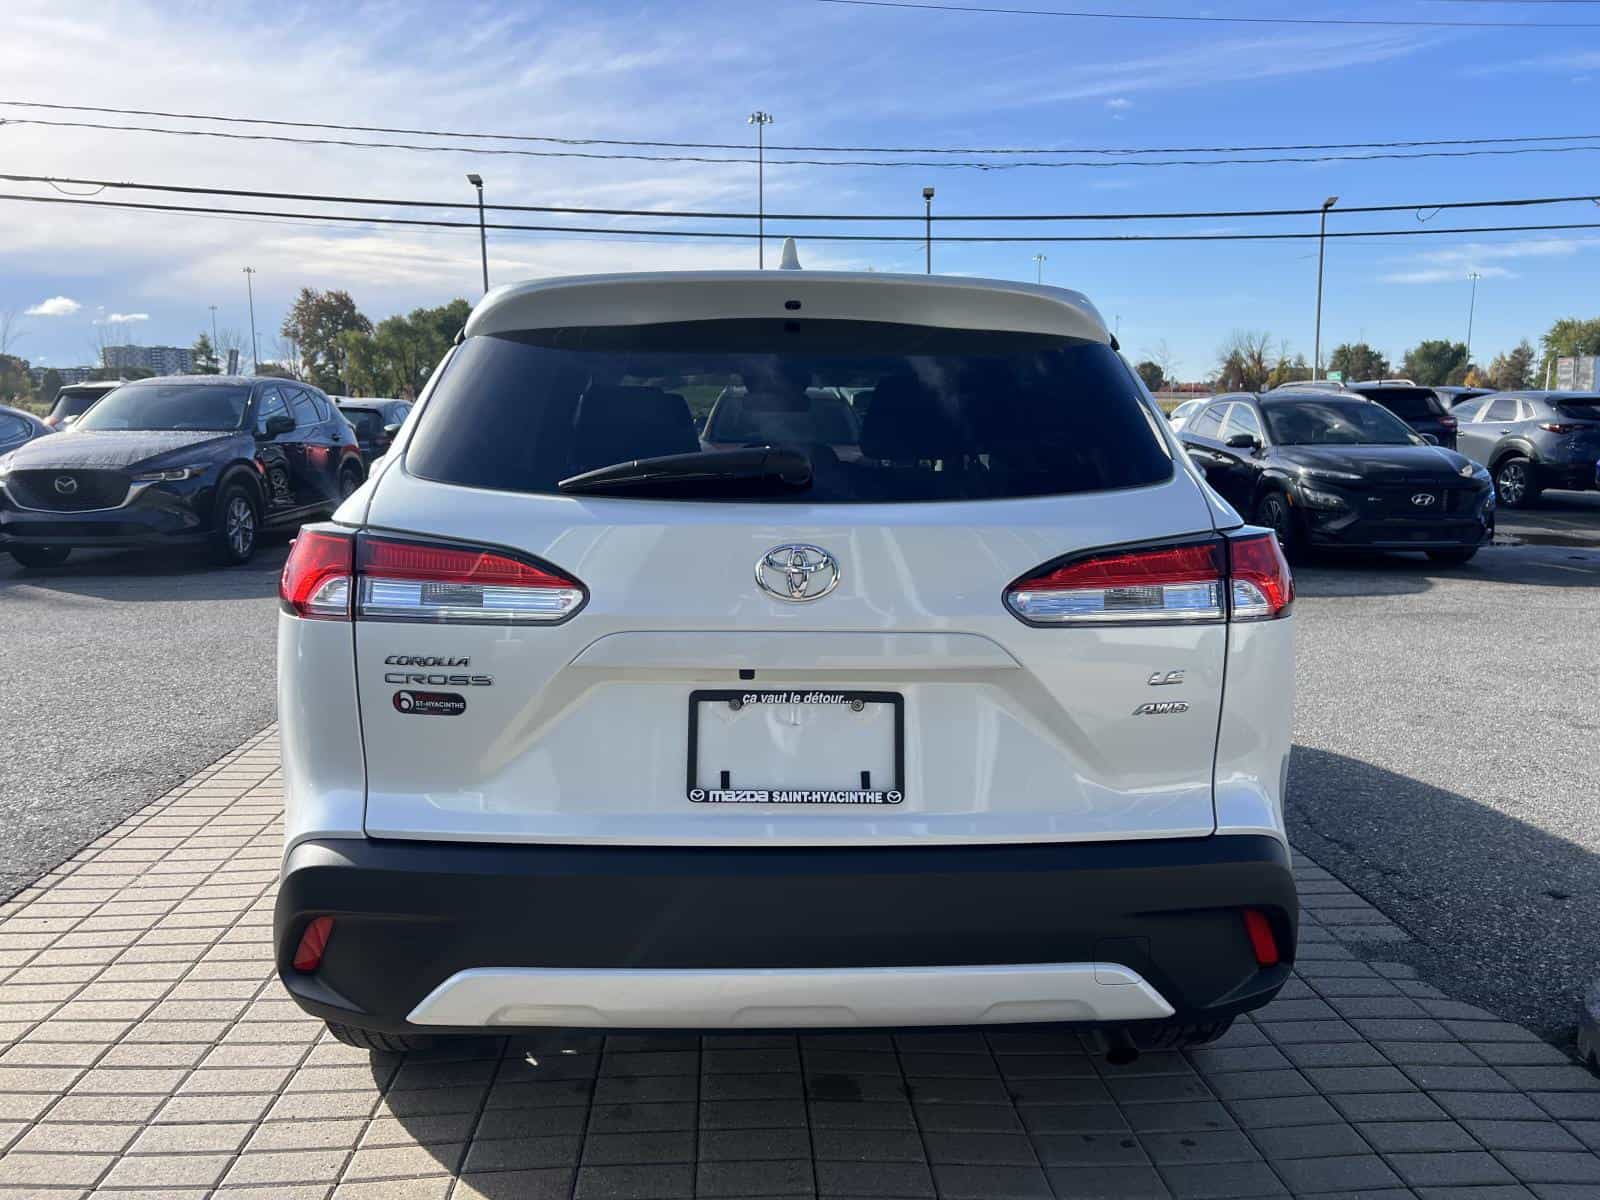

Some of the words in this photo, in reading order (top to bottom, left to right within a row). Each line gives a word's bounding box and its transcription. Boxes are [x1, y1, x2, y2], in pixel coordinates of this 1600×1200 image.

[385, 655, 470, 667] COROLLA
[384, 672, 493, 686] CROSS
[742, 692, 757, 705] ça
[761, 693, 788, 704] vaut
[789, 692, 801, 704] le
[1131, 700, 1189, 716] AWD
[772, 791, 883, 803] SAINT-HYACINTHE
